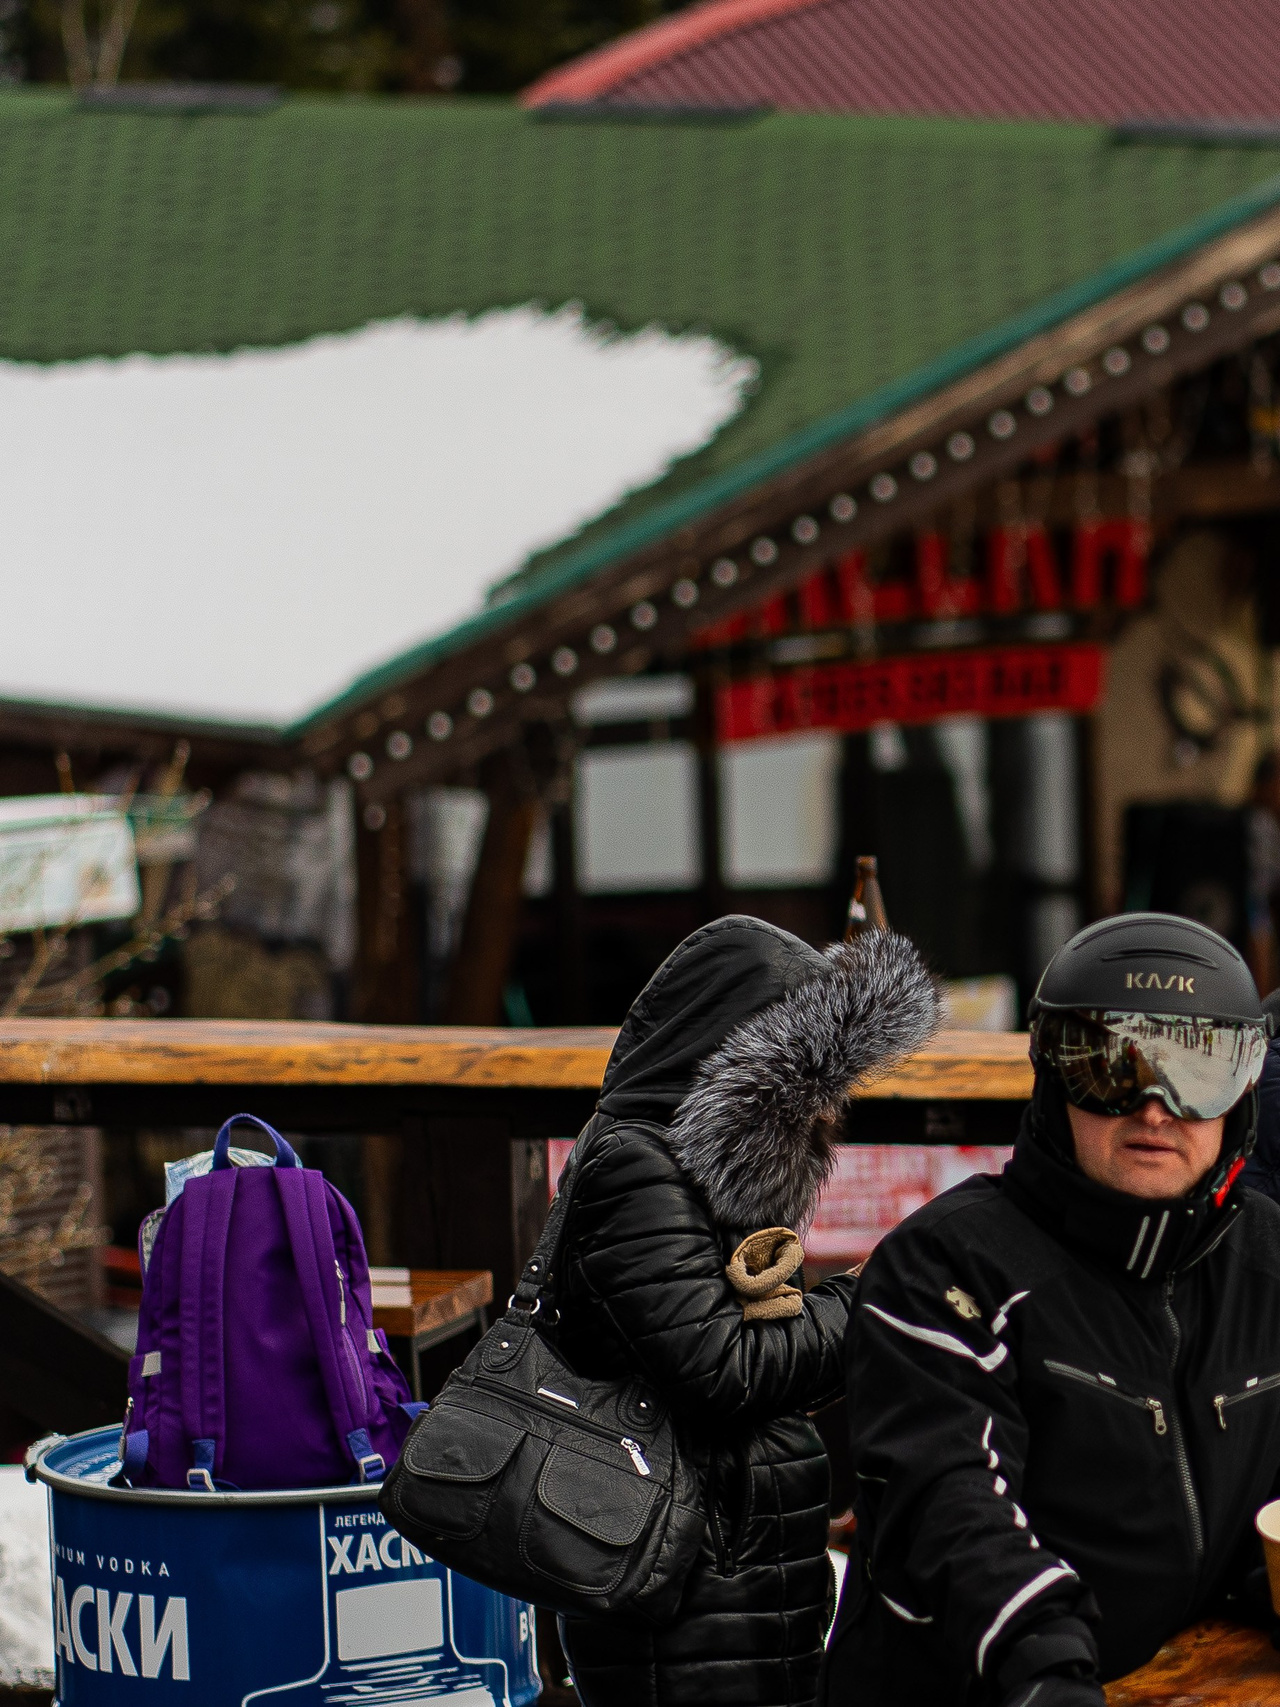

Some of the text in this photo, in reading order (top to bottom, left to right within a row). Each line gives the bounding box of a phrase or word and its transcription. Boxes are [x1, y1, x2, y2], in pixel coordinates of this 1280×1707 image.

[1126, 972, 1195, 994] KASK
[334, 1511, 386, 1528] ЛЕГЕНД
[326, 1528, 434, 1575] ХАСК
[96, 1554, 170, 1577] VODKA
[55, 1574, 191, 1681] АСКИ
